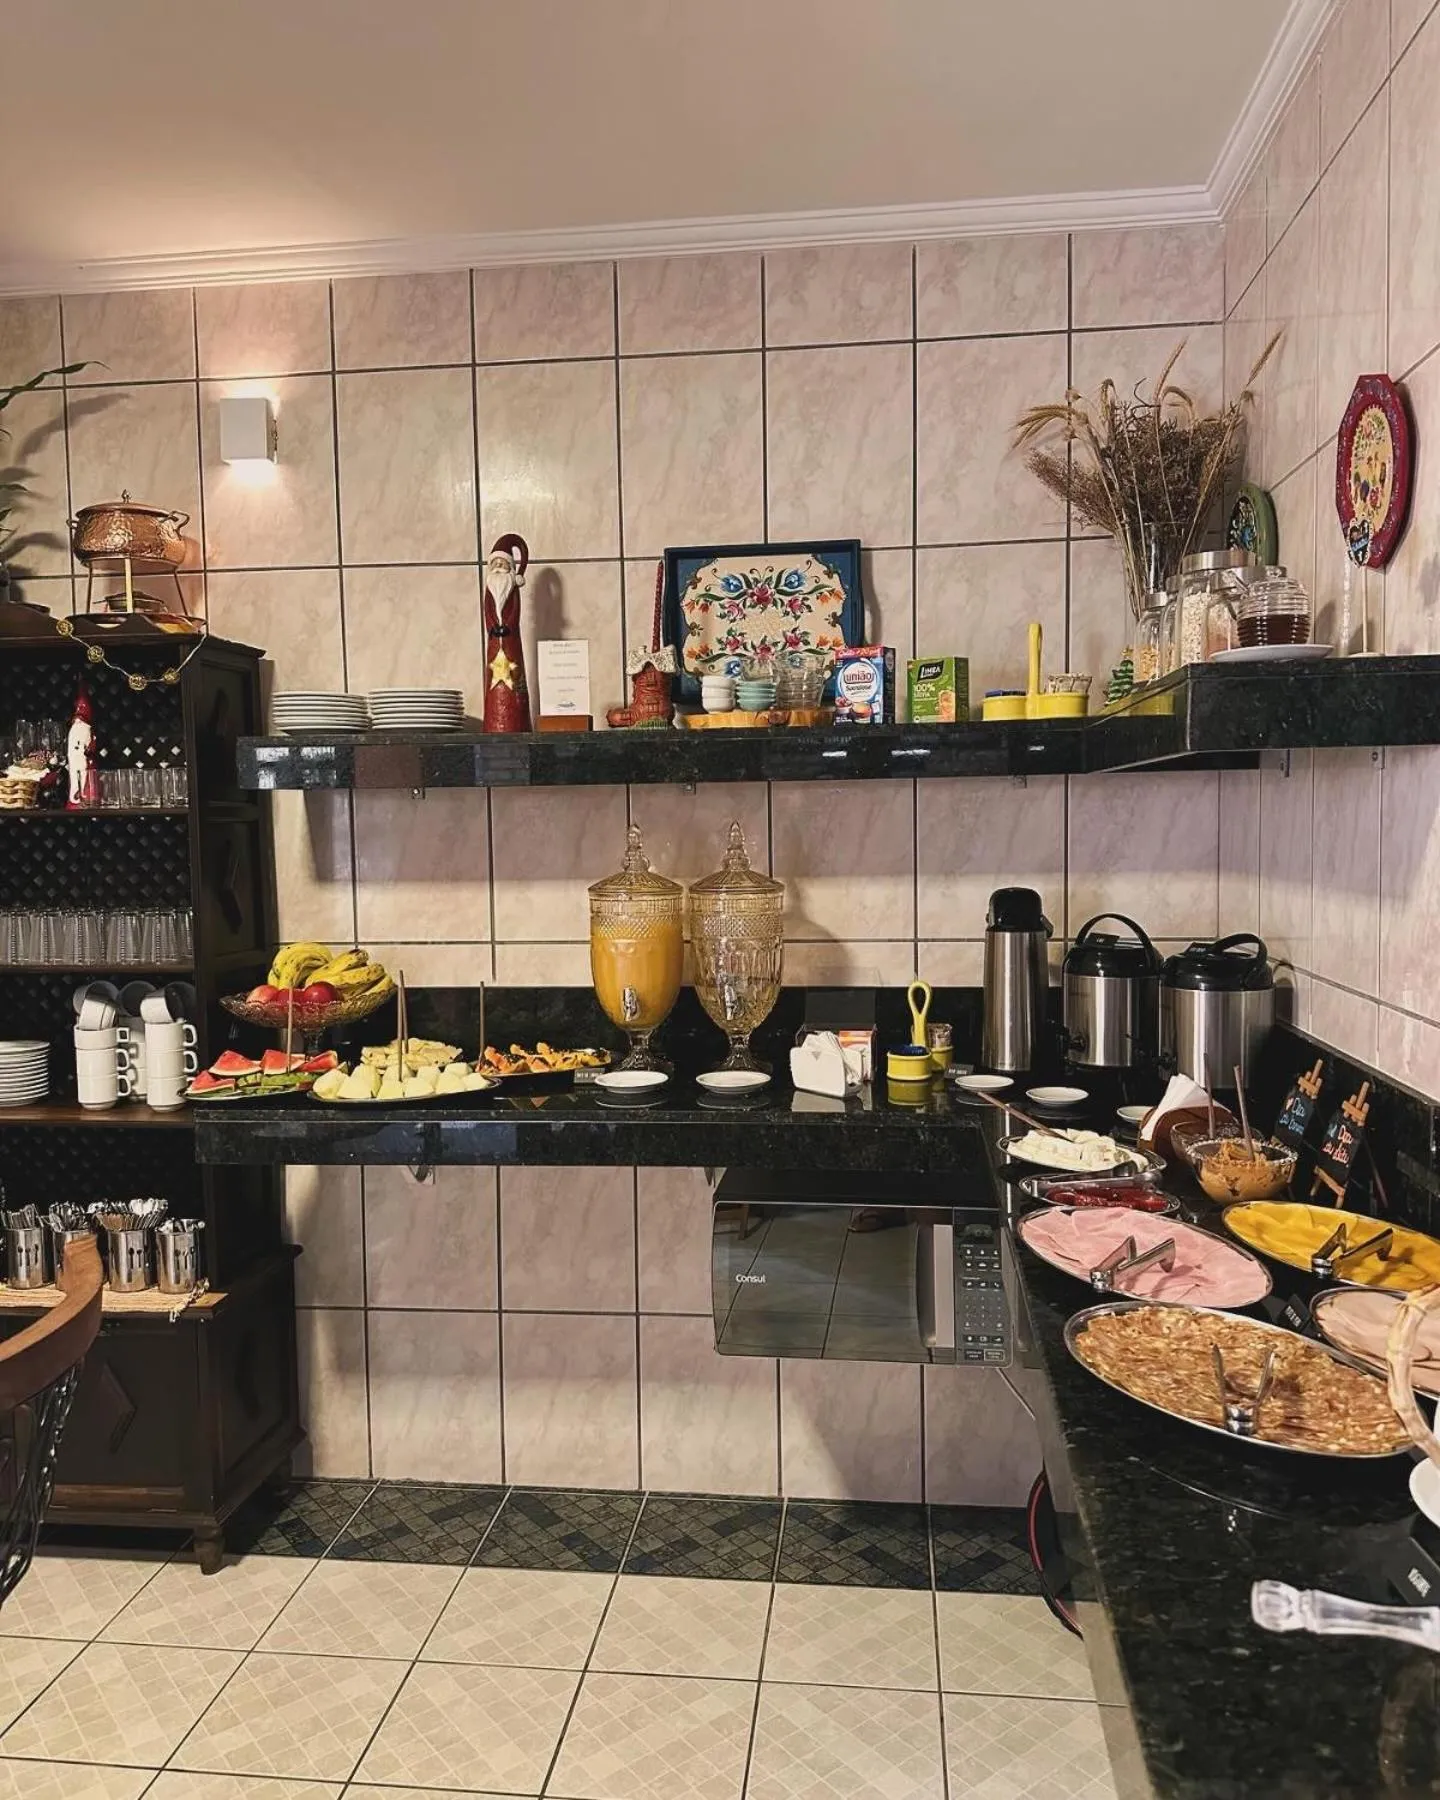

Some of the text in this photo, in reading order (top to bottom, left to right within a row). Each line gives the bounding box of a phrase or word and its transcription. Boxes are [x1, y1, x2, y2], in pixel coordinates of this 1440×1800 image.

[846, 671, 872, 682] união
[913, 683, 936, 692] 100%
[735, 1274, 766, 1283] Consul
